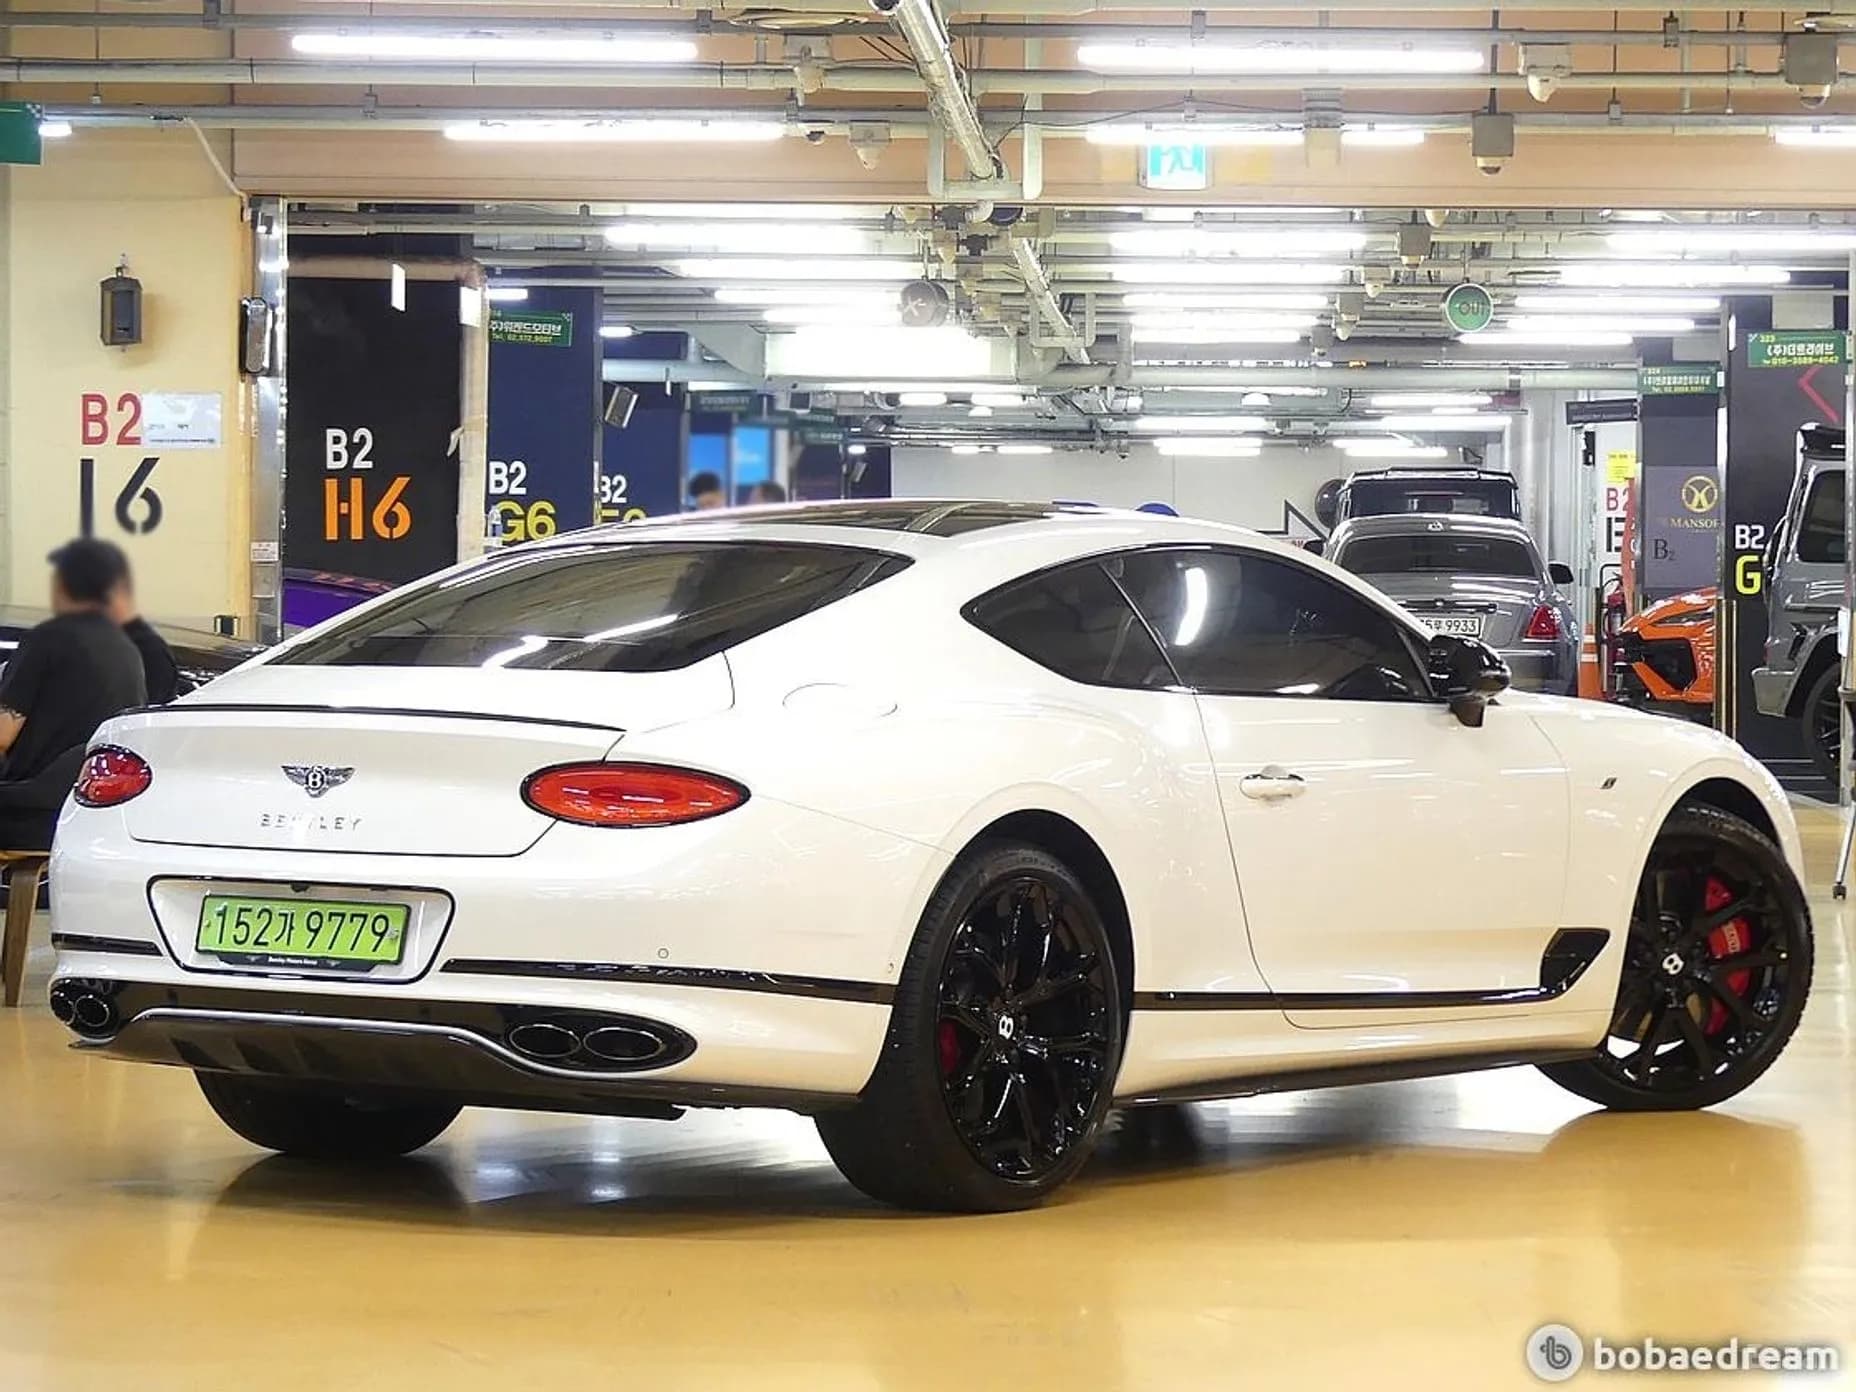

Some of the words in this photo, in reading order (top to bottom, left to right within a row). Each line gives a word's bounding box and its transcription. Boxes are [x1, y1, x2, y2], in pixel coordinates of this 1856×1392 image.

[81, 392, 142, 446] B2
[325, 427, 374, 470] B2
[489, 460, 527, 495] B2
[324, 476, 412, 541] H6
[497, 500, 557, 542] G6
[1734, 524, 1765, 550] B2
[1445, 619, 1476, 632] 9933
[214, 903, 295, 947] 152가
[305, 910, 390, 953] 9779
